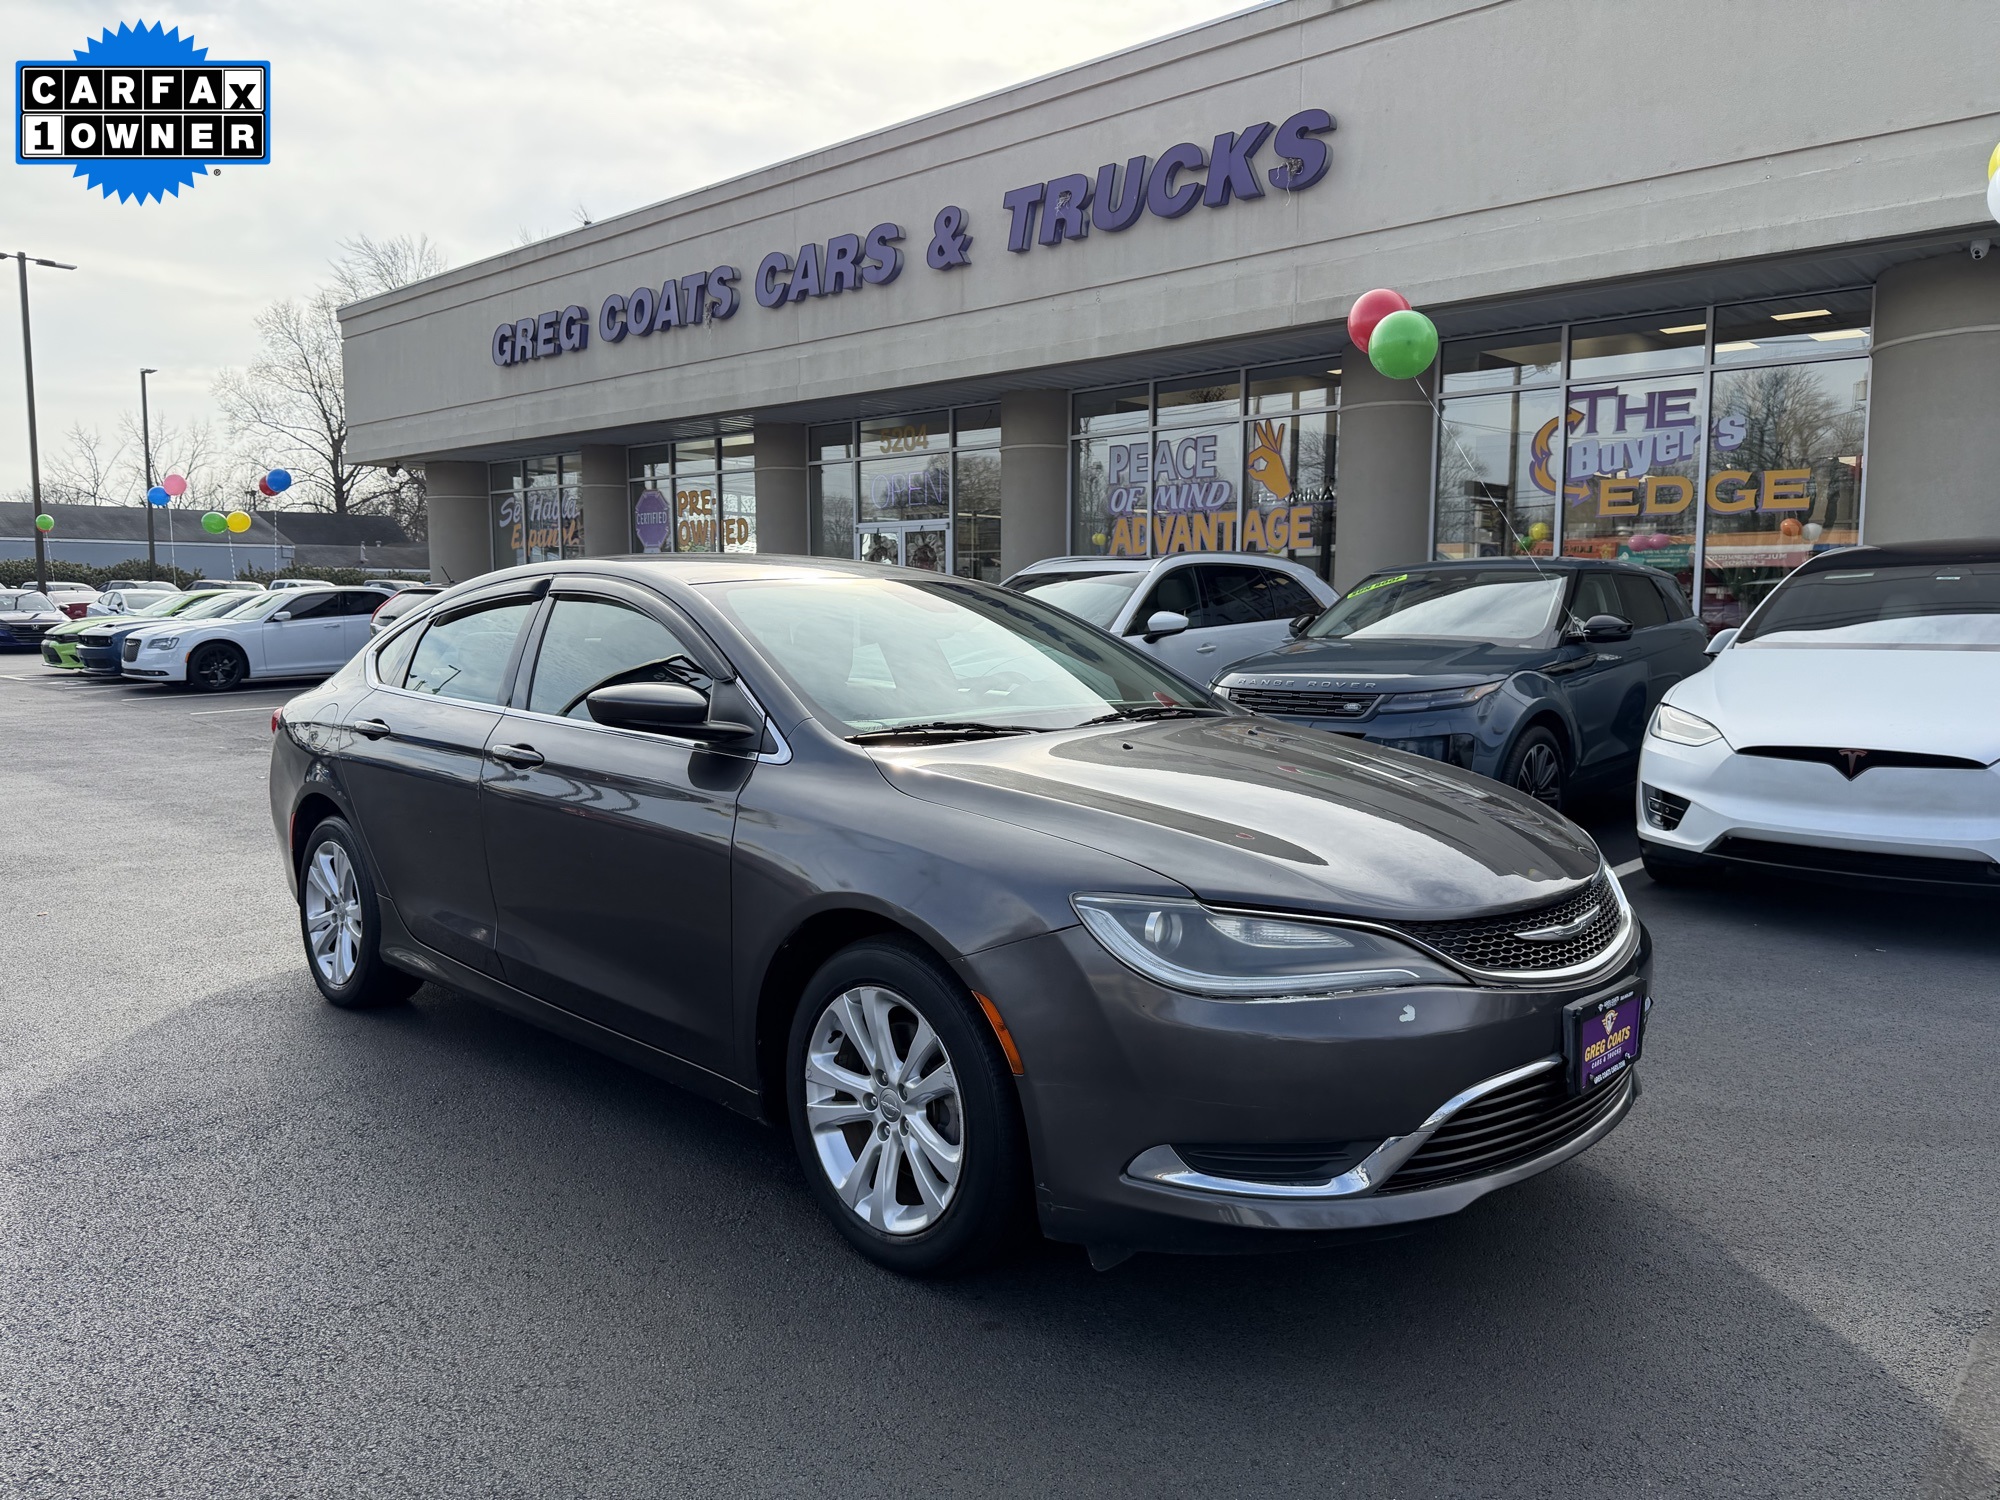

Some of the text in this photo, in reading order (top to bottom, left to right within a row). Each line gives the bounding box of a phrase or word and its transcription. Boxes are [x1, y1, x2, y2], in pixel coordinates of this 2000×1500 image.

[492, 108, 1337, 367] GREG COATS CARS & TRUCKS
[1568, 386, 1697, 435] THE
[880, 424, 929, 453] 5204
[1109, 435, 1217, 484] PEACE
[677, 489, 716, 517] PRE-
[872, 469, 942, 509] OPEN
[1110, 481, 1233, 514] OF MIND
[1597, 467, 1811, 517] EDGE
[499, 496, 521, 528] Se
[637, 511, 668, 525] CERTIFIED
[511, 519, 580, 556] Epañl
[678, 518, 749, 546] OWNED
[1109, 506, 1314, 556] ADVANTAGE
[1237, 677, 1377, 689] RANGE ROVER
[1584, 1025, 1631, 1062] GREG COATS
[1591, 1058, 1603, 1069] CARS
[1607, 1047, 1622, 1060] TRUCKS
